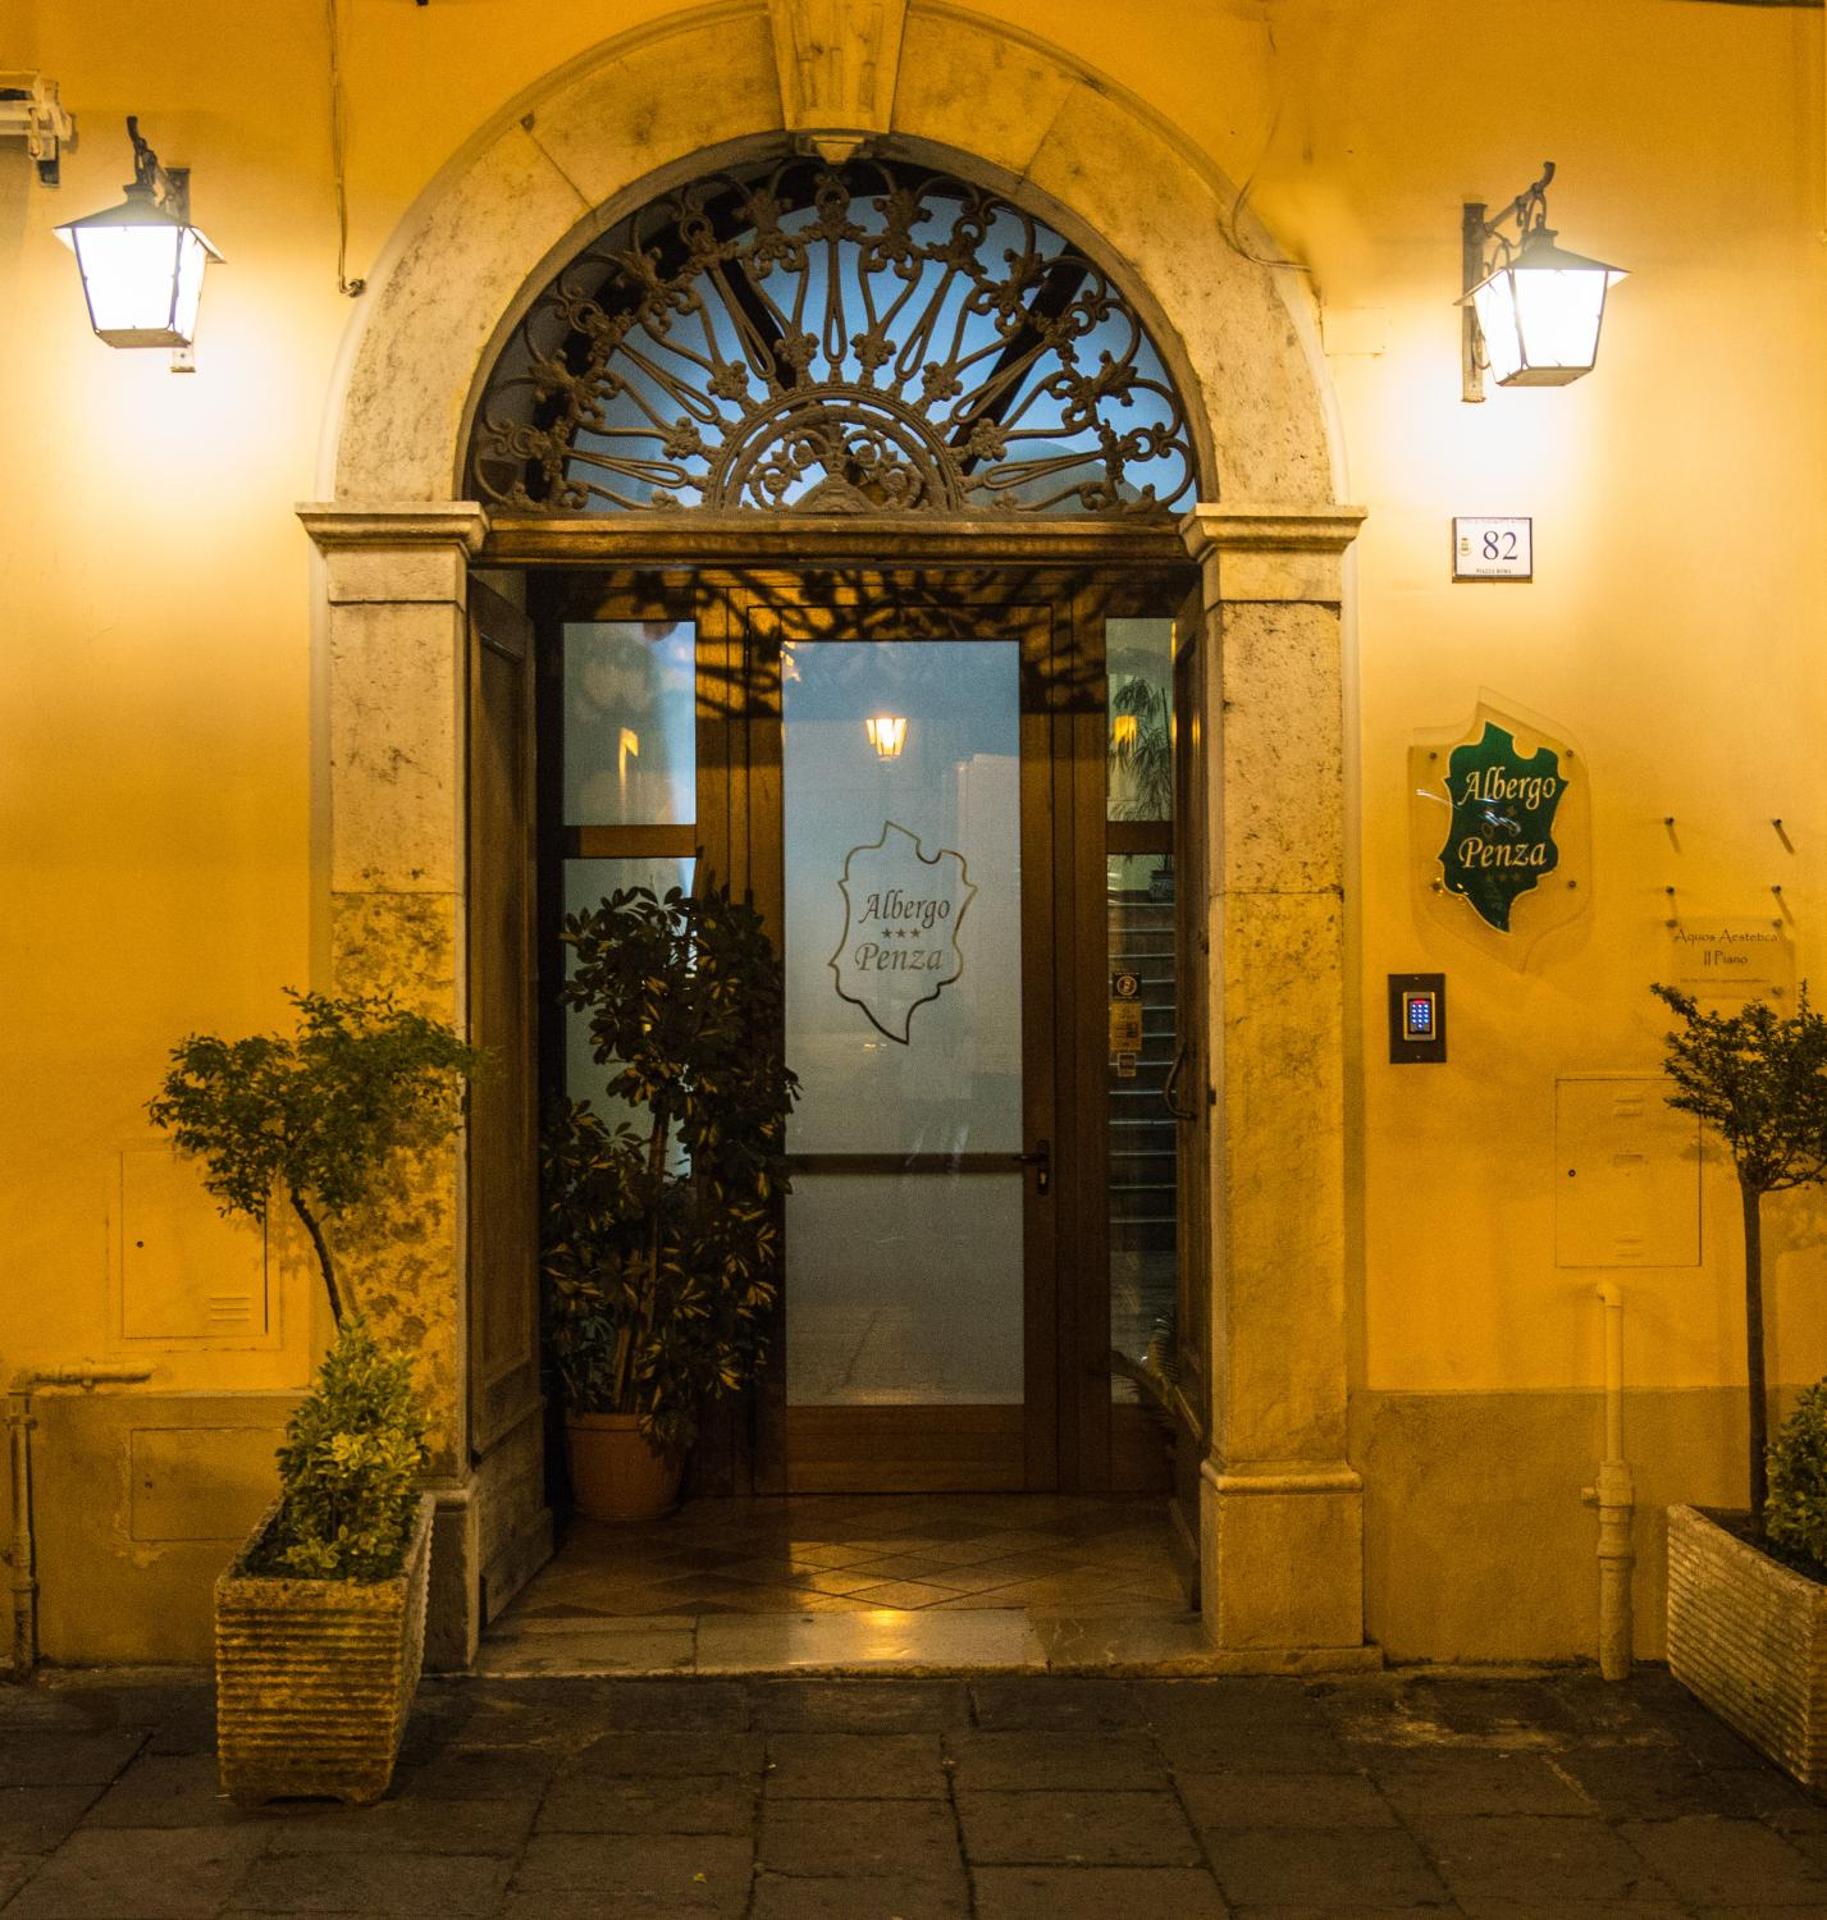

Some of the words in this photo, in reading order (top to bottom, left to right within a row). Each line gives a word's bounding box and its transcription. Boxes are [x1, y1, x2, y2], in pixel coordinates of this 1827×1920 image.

[1482, 530, 1518, 560] 82
[1457, 766, 1556, 810] Albergo
[1458, 836, 1547, 869] Penza
[858, 890, 951, 929] Albergo
[855, 942, 944, 971] Penza
[1714, 950, 1748, 966] Piano
